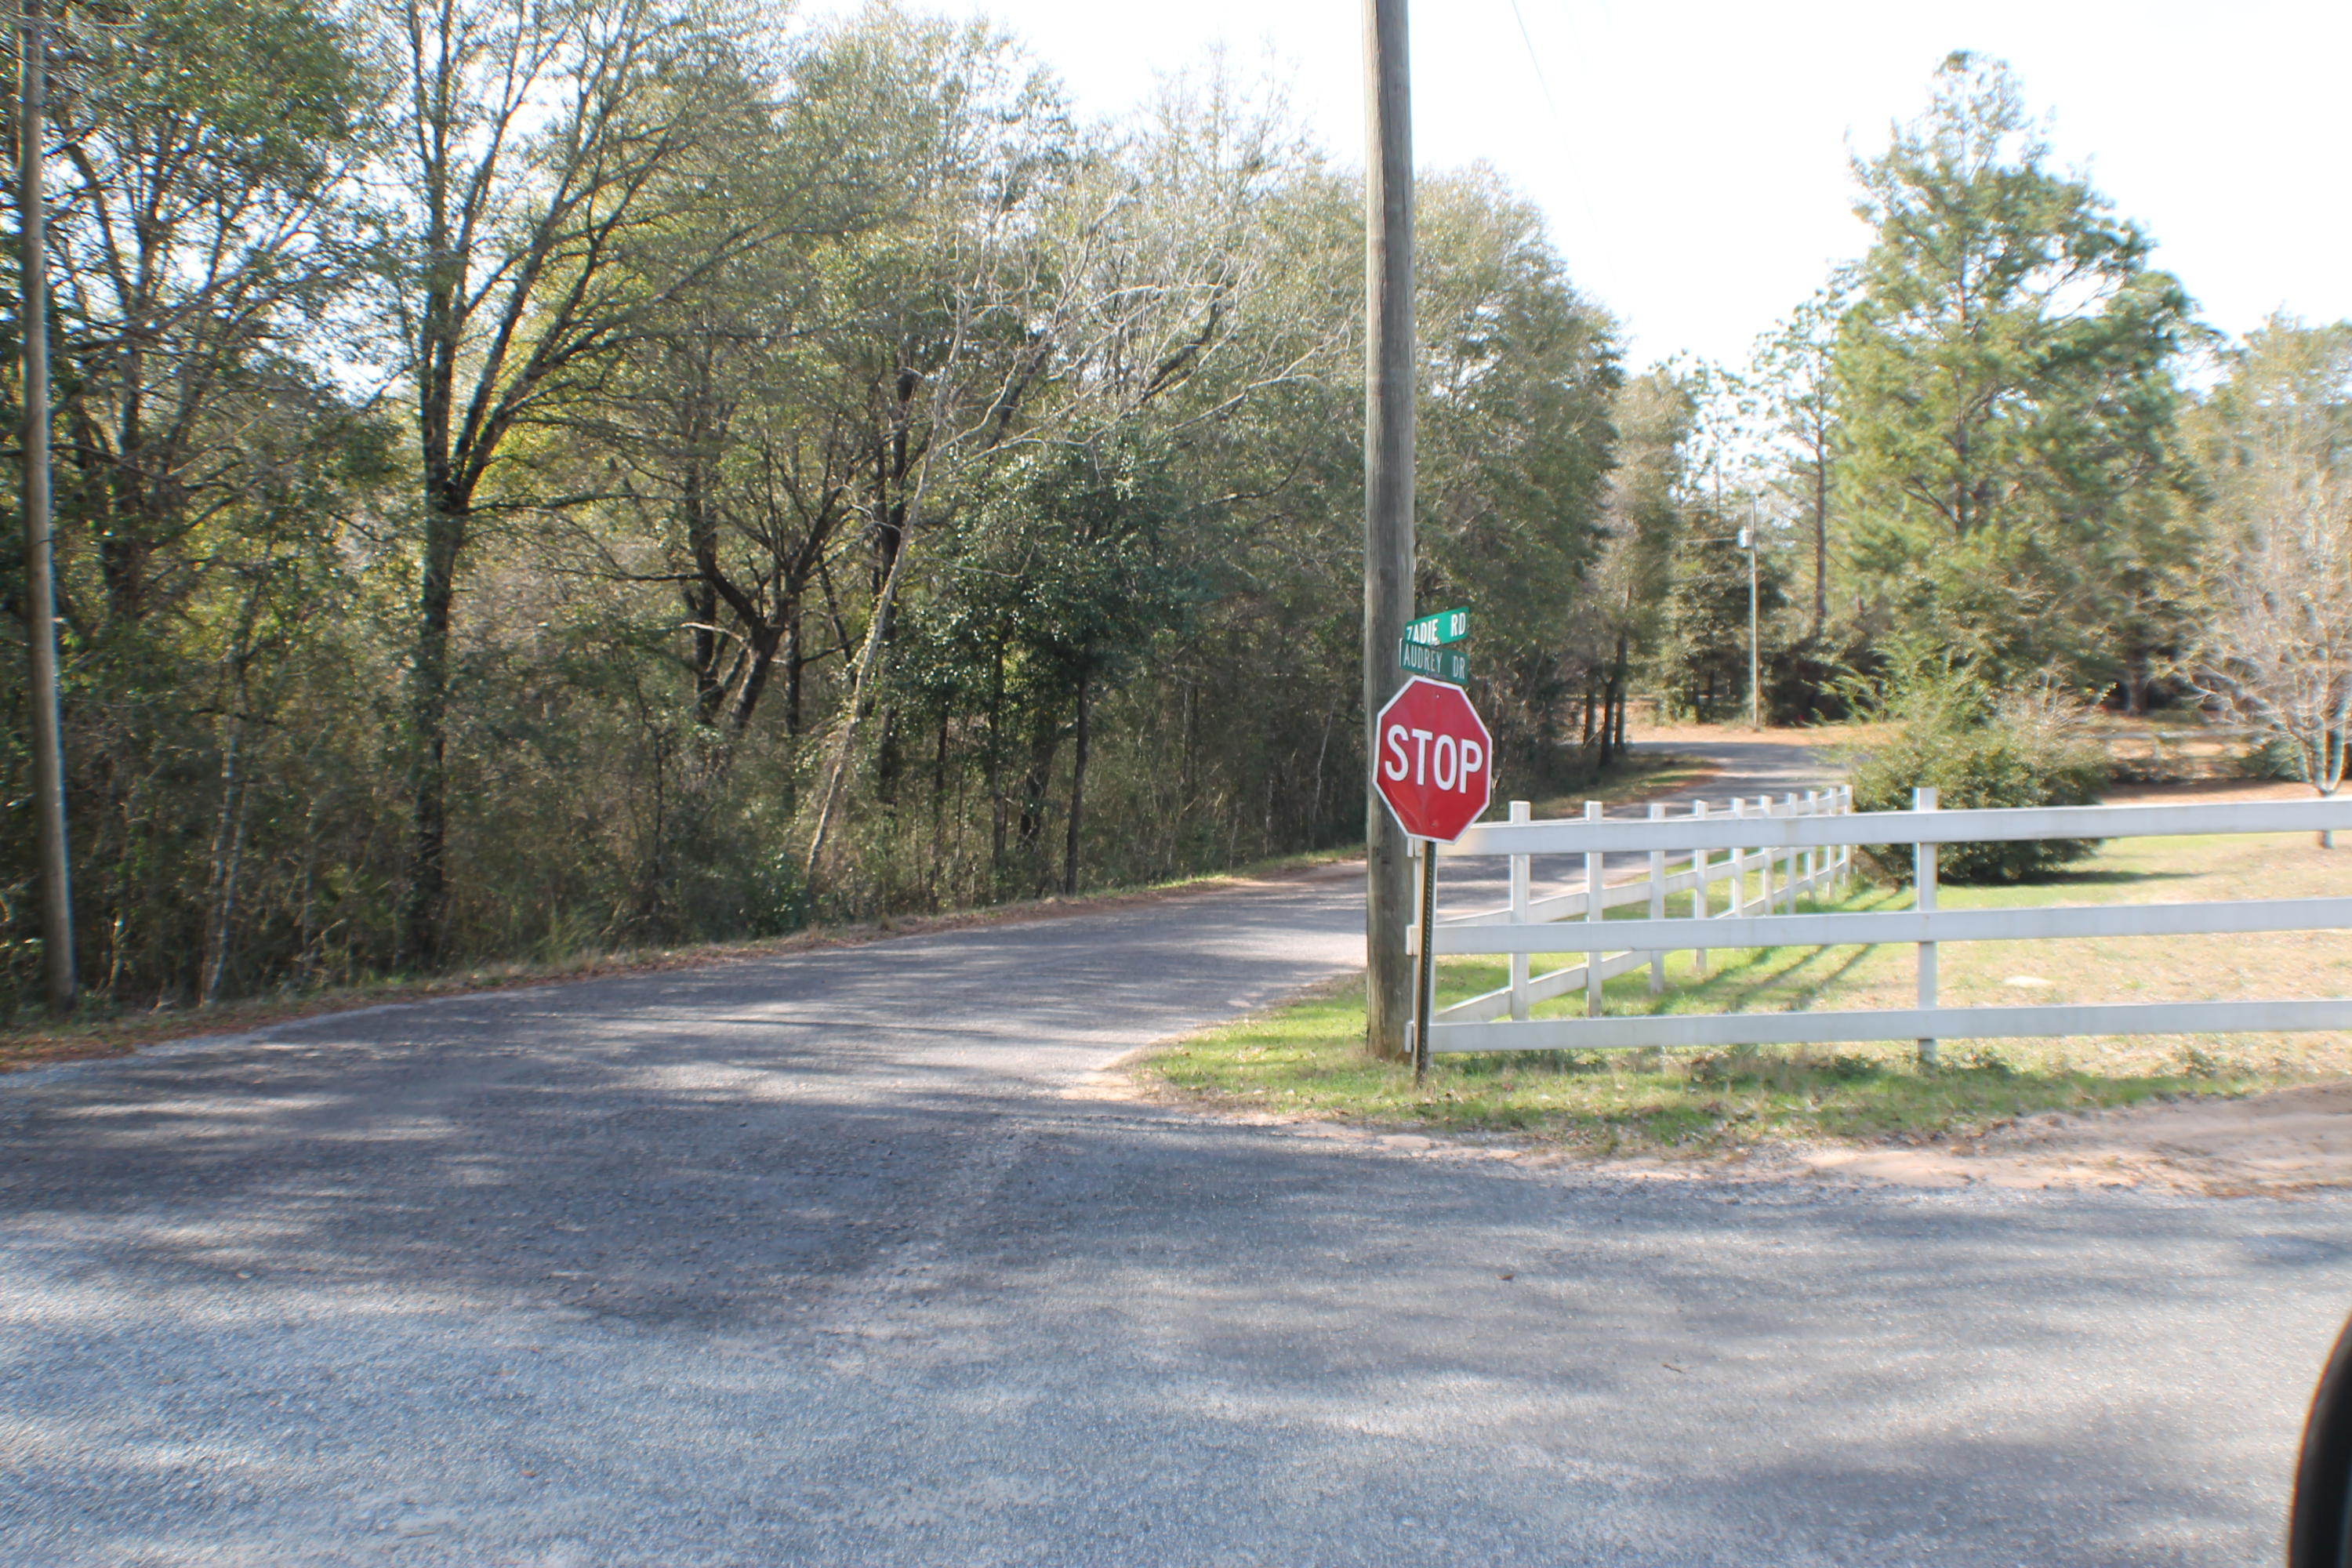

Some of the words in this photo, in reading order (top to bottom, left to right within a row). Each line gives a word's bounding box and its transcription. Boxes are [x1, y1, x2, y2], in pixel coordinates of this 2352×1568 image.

[1451, 612, 1466, 637] RD
[1403, 644, 1443, 673] AUDREY
[1453, 655, 1465, 679] DR
[1385, 724, 1483, 793] STOP
